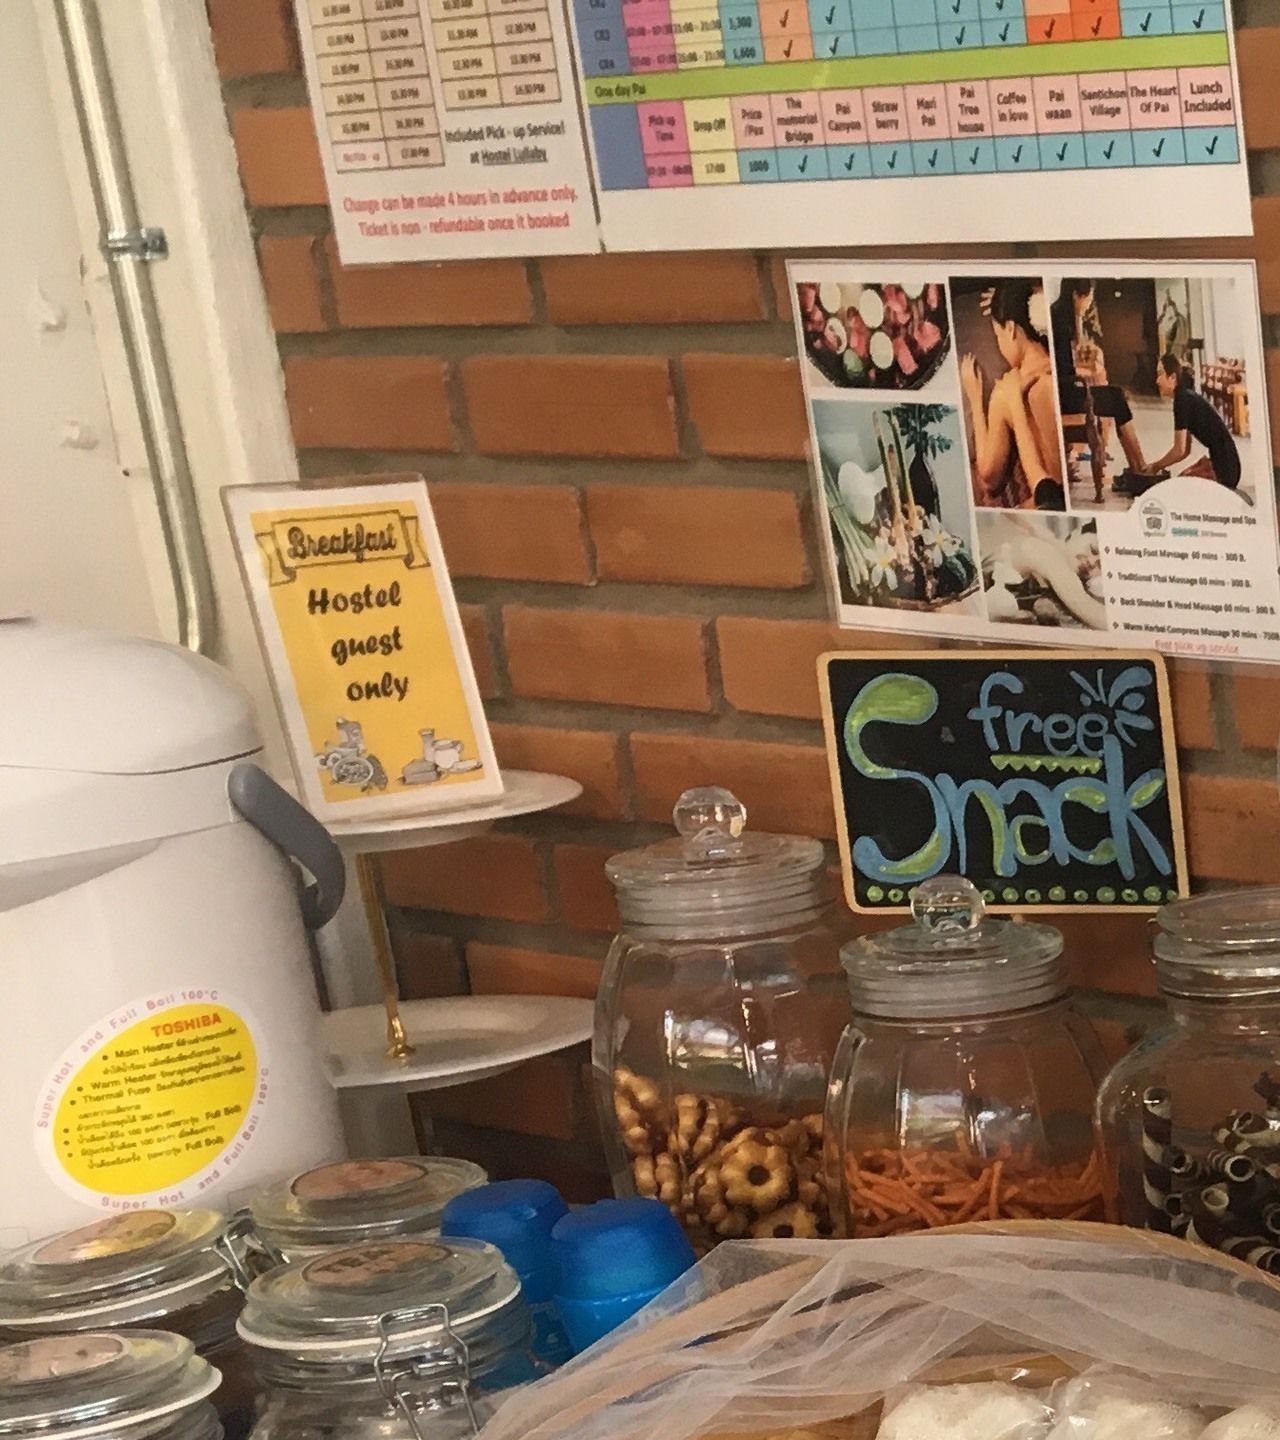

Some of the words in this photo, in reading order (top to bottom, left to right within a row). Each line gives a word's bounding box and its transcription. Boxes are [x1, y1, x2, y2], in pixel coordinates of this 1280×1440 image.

[1130, 85, 1146, 97] The
[1150, 85, 1177, 97] Heart
[1190, 82, 1222, 95] Lunch
[1184, 99, 1231, 113] Included
[288, 522, 397, 562] Breakfast
[308, 581, 402, 615] Hostel
[331, 626, 403, 666] guest
[347, 672, 408, 701] only
[967, 671, 1108, 757] free
[844, 673, 1172, 883] Snack
[150, 1012, 222, 1038] TOSHIBA
